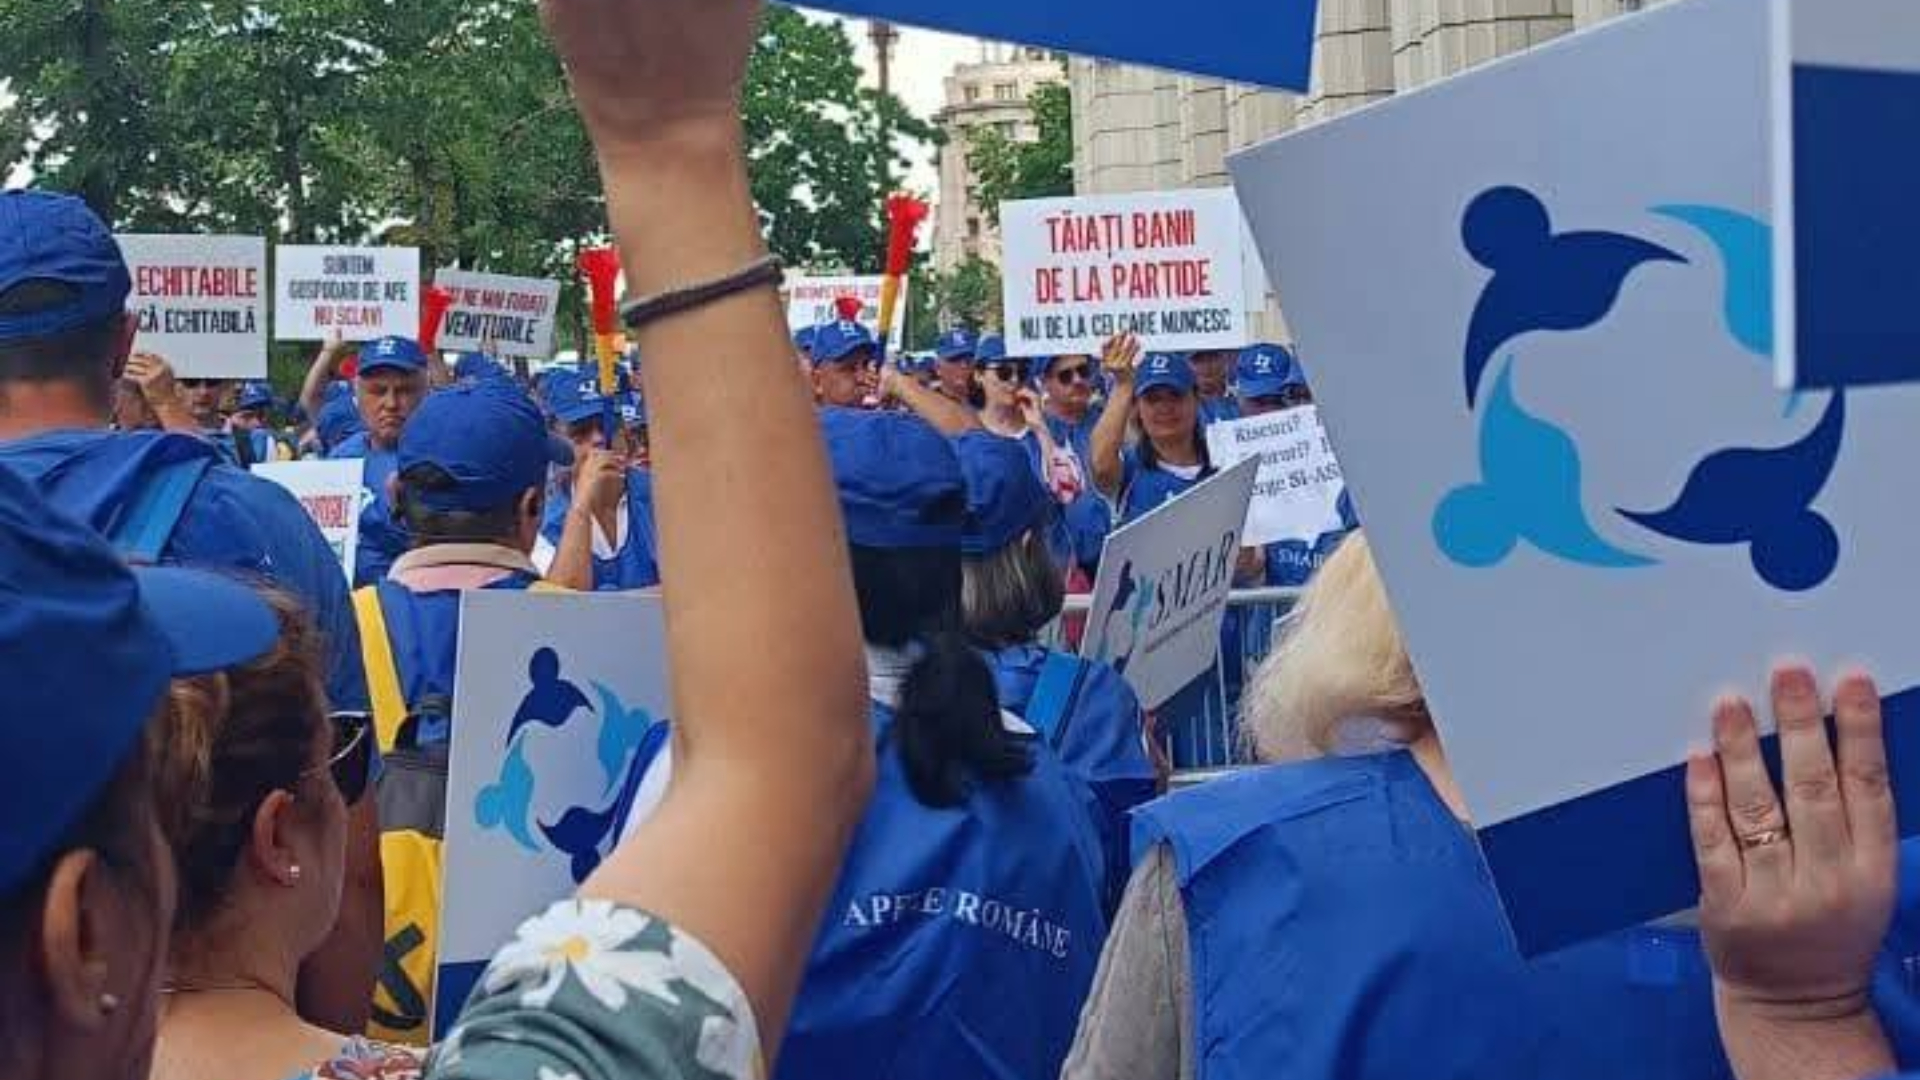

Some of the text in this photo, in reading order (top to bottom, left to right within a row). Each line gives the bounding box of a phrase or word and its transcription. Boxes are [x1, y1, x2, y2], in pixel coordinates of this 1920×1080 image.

[1046, 209, 1195, 258] TĂIAȚI BANII
[136, 265, 257, 297] ECHITABILE
[1035, 260, 1211, 304] DE LA PARTIDE
[132, 304, 256, 333] CĂ ECHITABILĂ
[445, 310, 539, 345] VENITURILE
[1020, 308, 1232, 340] NU DE LA CEI CARE MUNCESC
[1153, 529, 1236, 628] SMAR
[954, 891, 1072, 959] ROMÂNE
